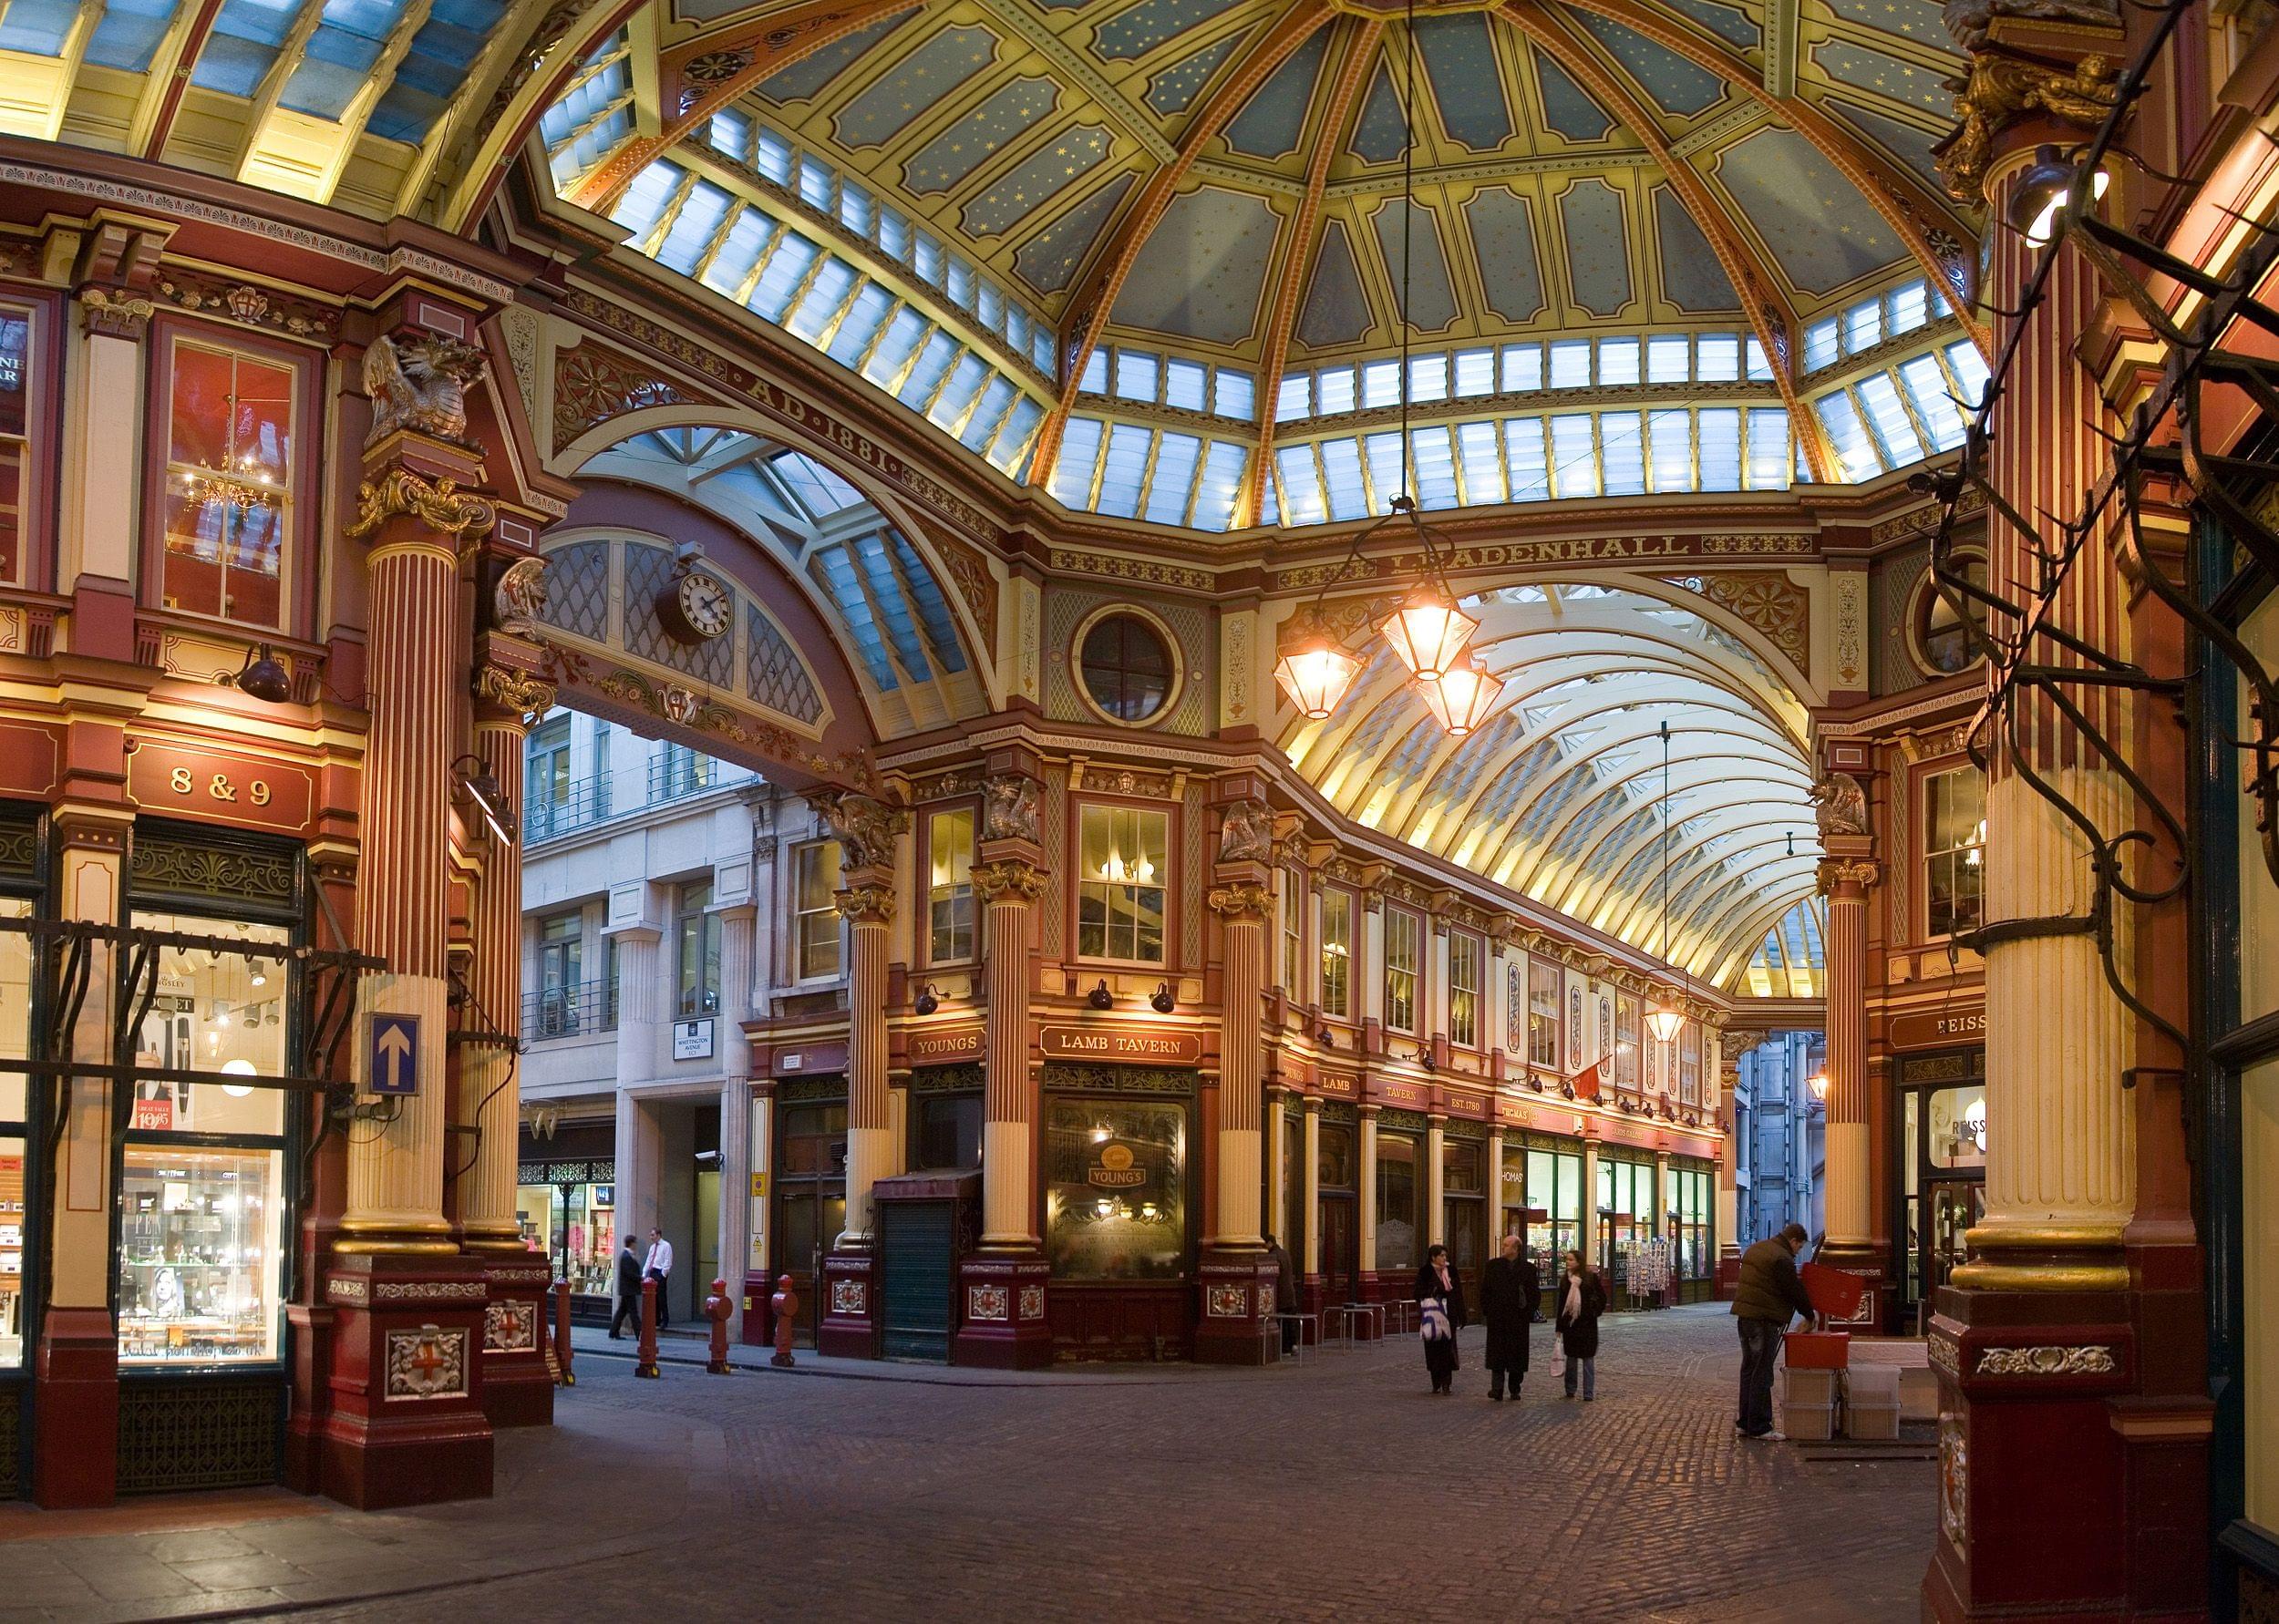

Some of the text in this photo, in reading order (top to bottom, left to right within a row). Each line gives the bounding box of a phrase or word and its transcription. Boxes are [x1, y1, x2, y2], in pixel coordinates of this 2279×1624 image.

[747, 379, 887, 472] AD 1881
[170, 767, 271, 806] 8 & 9
[158, 980, 184, 989] NGSLEY
[677, 1037, 708, 1045] WHITTINGTON
[918, 1036, 977, 1054] YOUNGS
[1061, 1035, 1181, 1054] LAMB TAVERN
[1323, 1077, 1350, 1091] LAMB
[1386, 1086, 1417, 1100] TAVERN
[1094, 1172, 1141, 1183] YOUNG'S
[1501, 1171, 1523, 1183] HOMAS'
[1615, 1260, 1627, 1269] CARD
